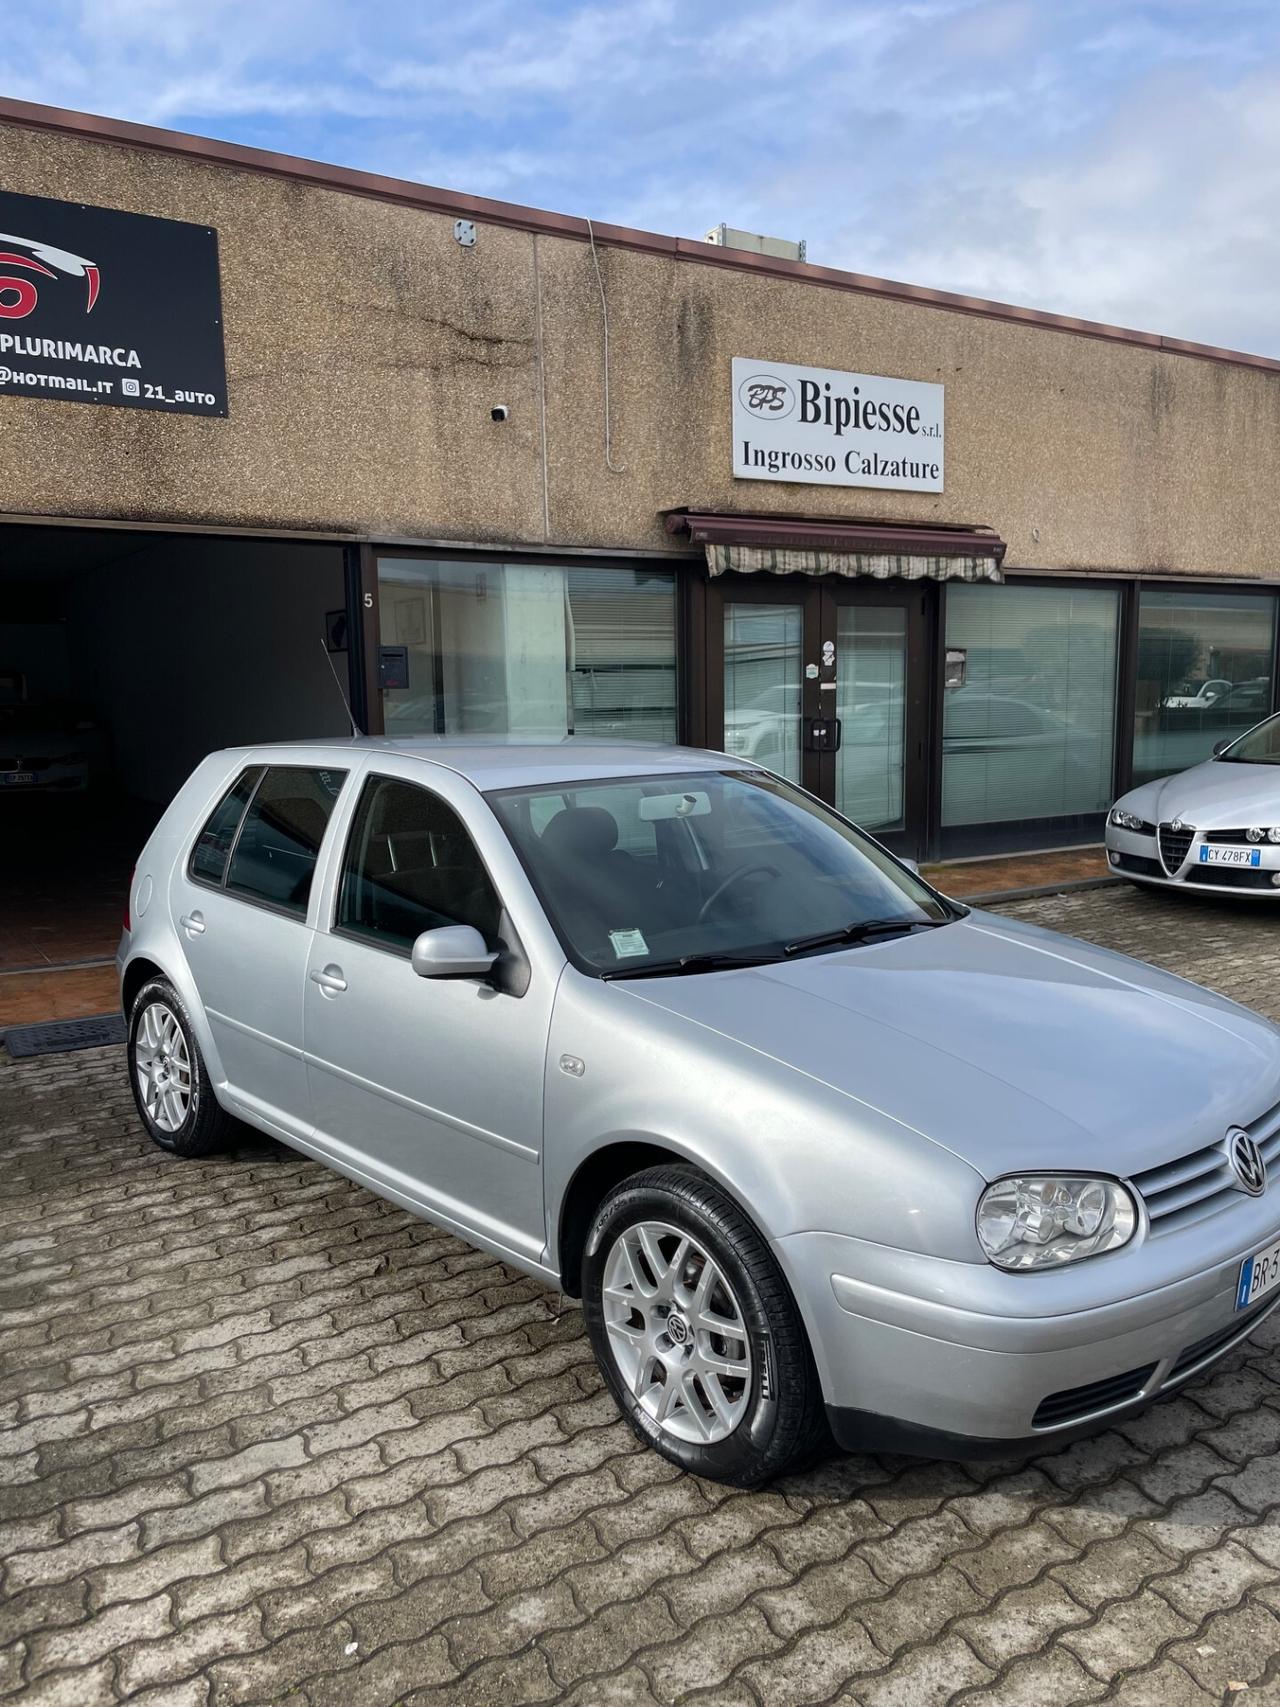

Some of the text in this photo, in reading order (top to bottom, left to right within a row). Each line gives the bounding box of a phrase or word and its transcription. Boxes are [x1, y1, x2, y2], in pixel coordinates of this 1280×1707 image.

[0, 333, 142, 369] PLURIMARCA
[797, 378, 942, 438] Bipiesse s.r.l.
[742, 441, 940, 480] Ingrosso Calzature
[363, 593, 374, 608] 5
[1208, 849, 1251, 863] CY 478FX
[1251, 1257, 1270, 1294] BR
